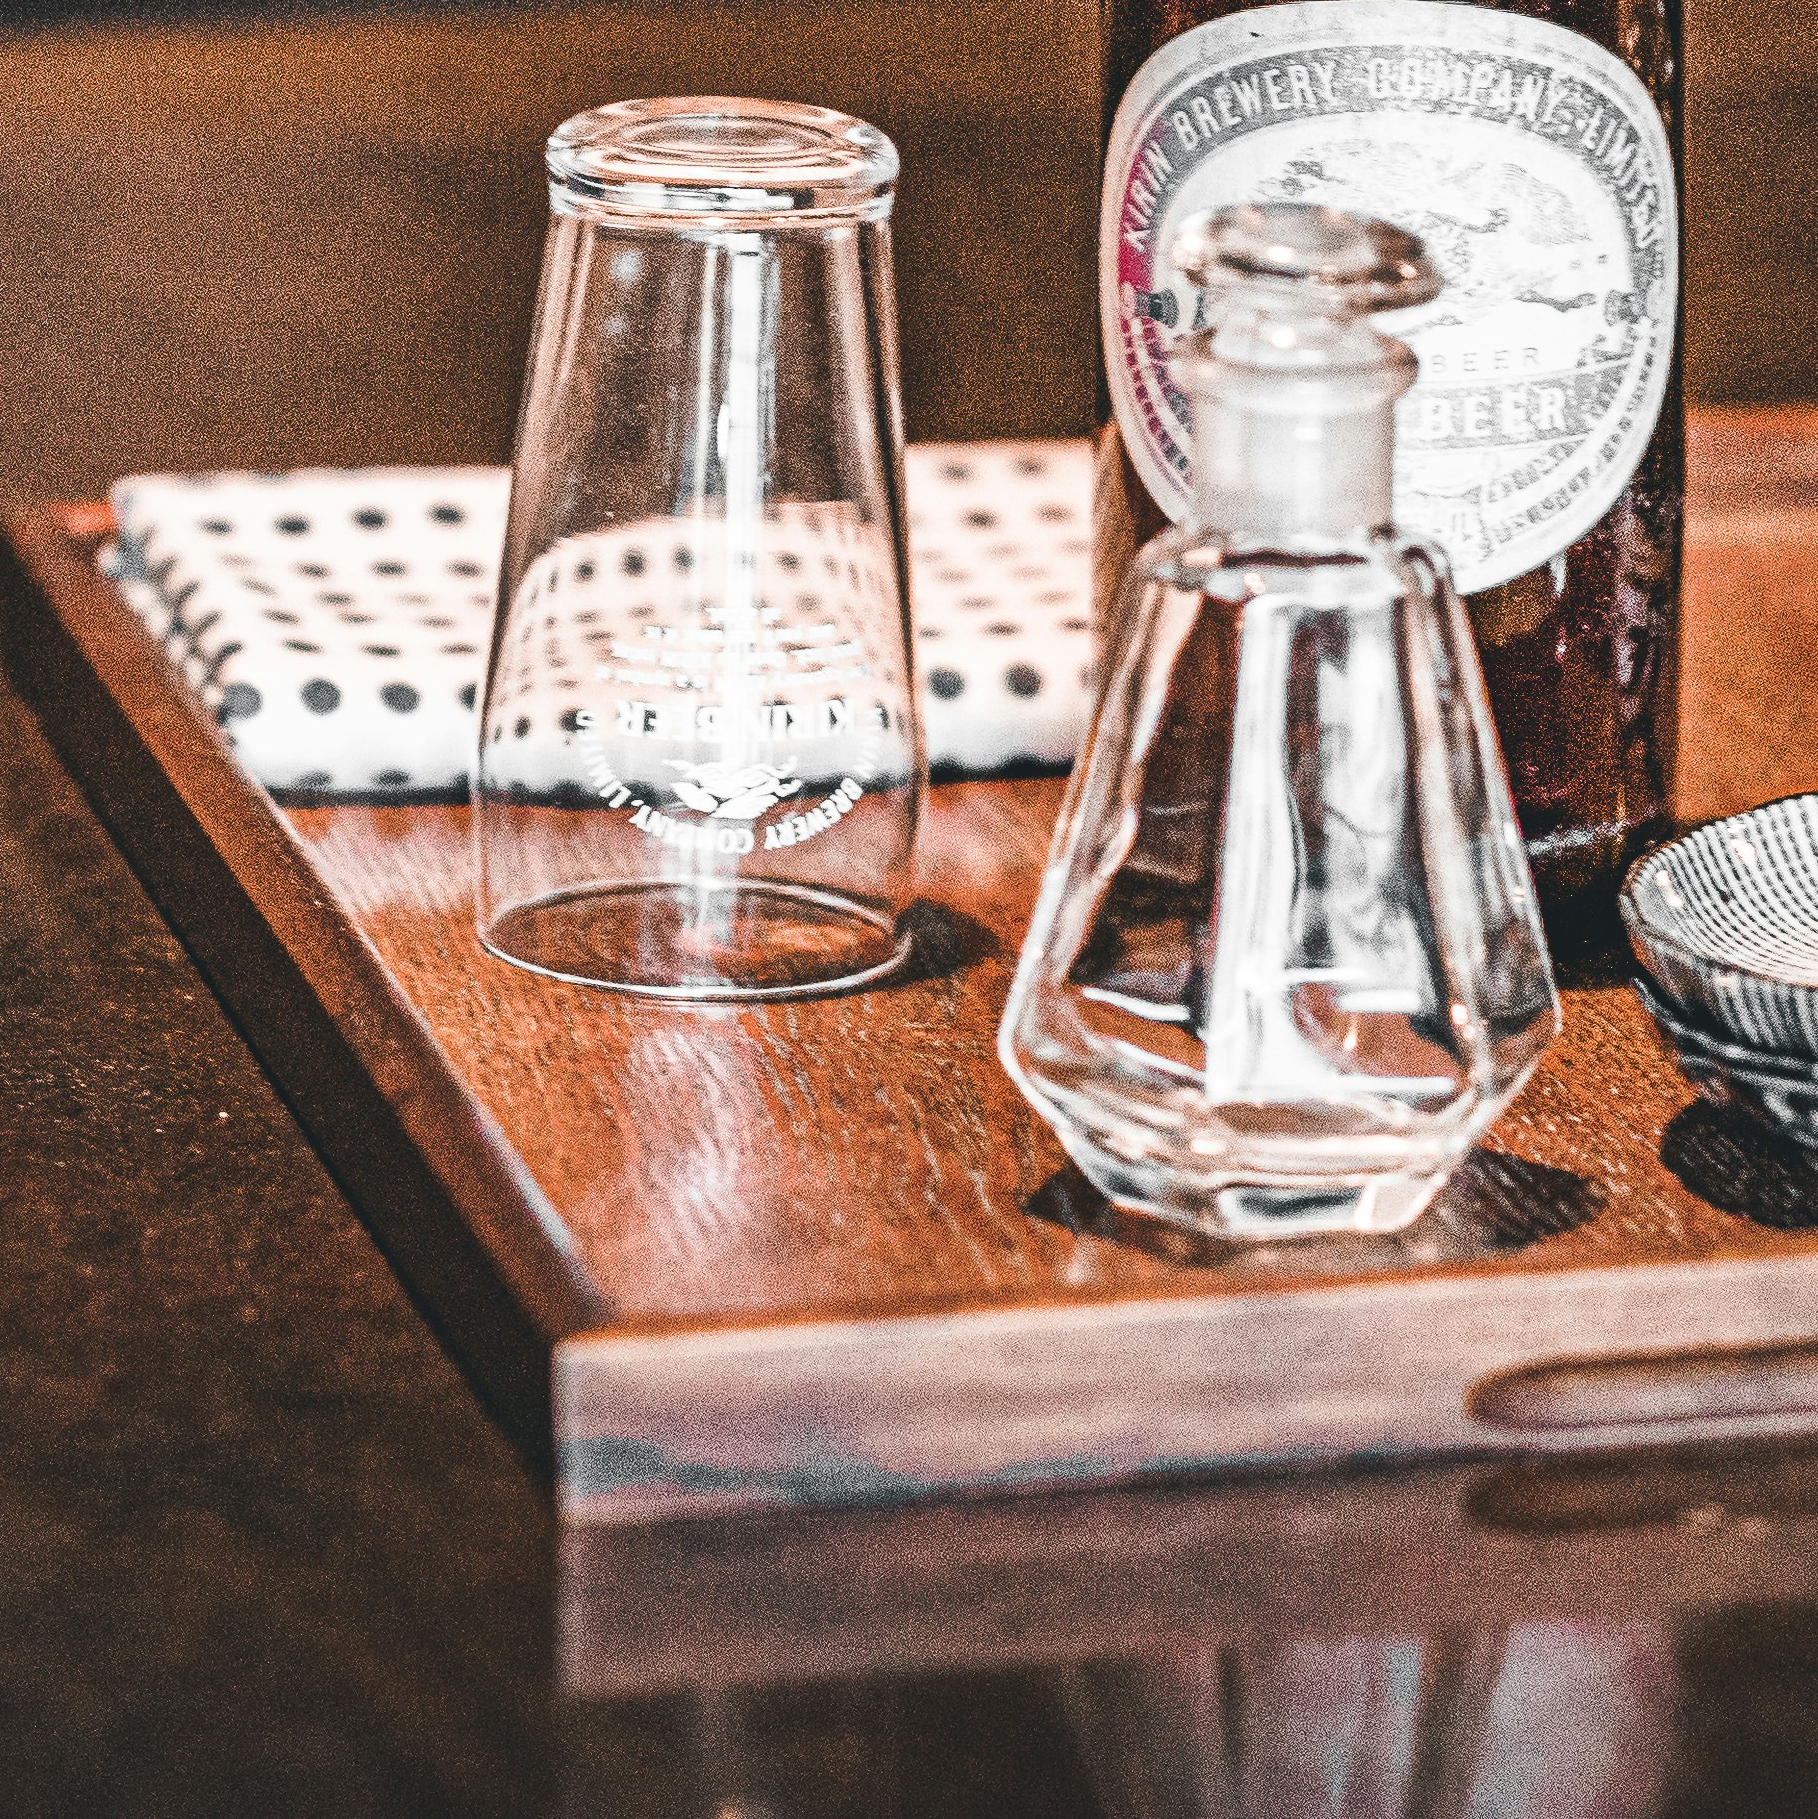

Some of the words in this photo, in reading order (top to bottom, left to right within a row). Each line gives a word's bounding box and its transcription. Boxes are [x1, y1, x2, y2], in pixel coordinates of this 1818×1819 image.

[1120, 139, 1175, 253] KIRIN
[1171, 59, 1341, 152] BREWERY
[1430, 346, 1541, 374] BEER
[1419, 387, 1567, 439] BEER
[614, 700, 724, 744] BEER
[739, 698, 855, 744] KIRIN
[763, 777, 863, 851] BREWERY
